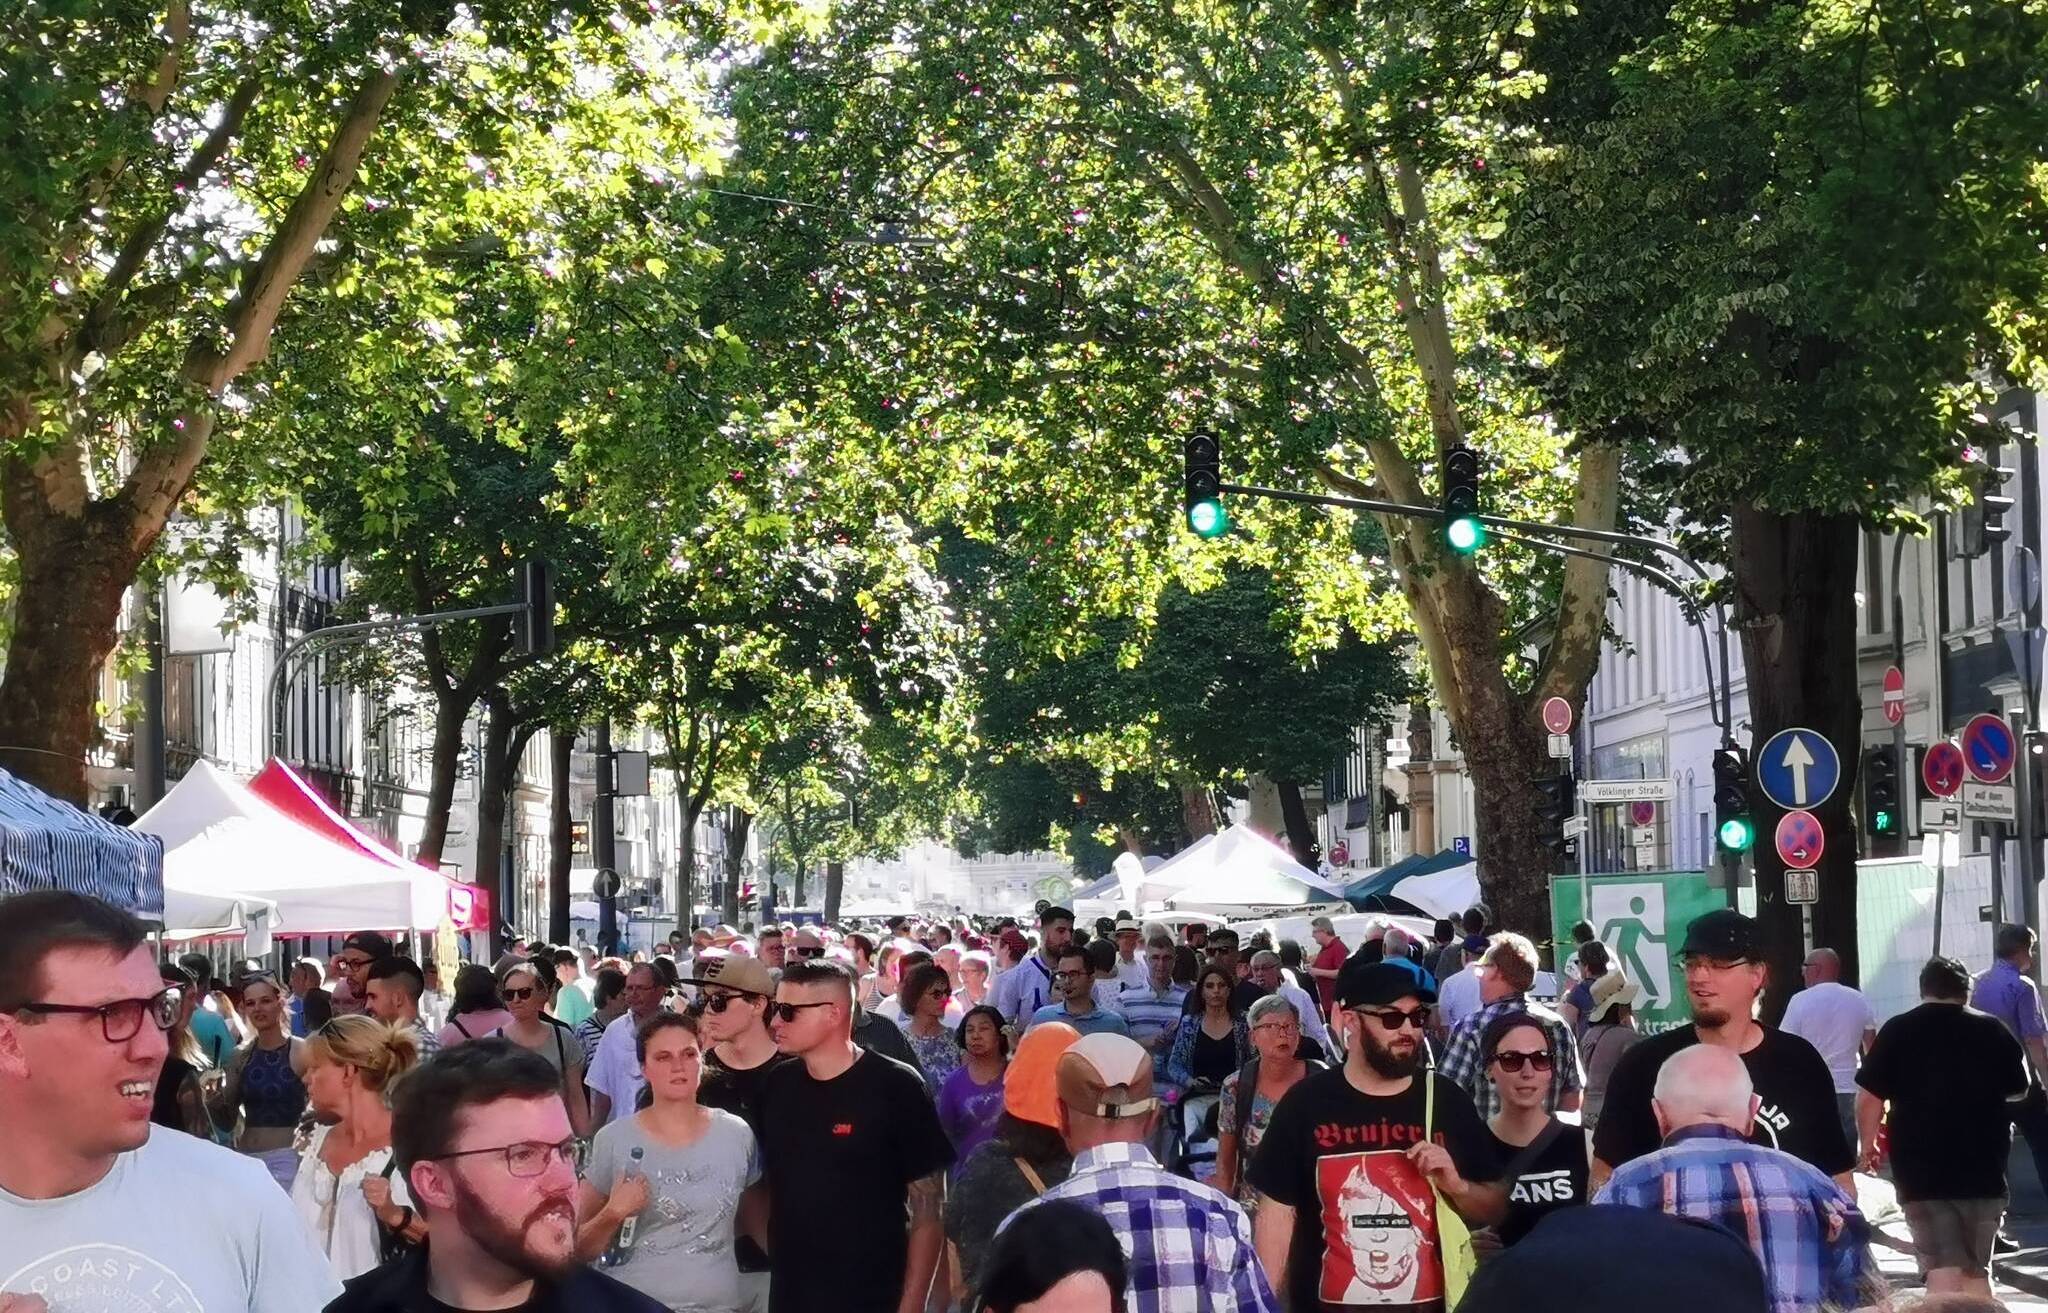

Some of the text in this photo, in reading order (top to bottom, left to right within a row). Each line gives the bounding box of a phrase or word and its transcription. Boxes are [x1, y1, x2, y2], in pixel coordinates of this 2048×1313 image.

[1597, 784, 1664, 798] Völklinger Straße
[1313, 1116, 1447, 1149] Brujera
[1509, 1169, 1574, 1203] ANS
[30, 1257, 142, 1296] COAST
[152, 1278, 191, 1313] LT
